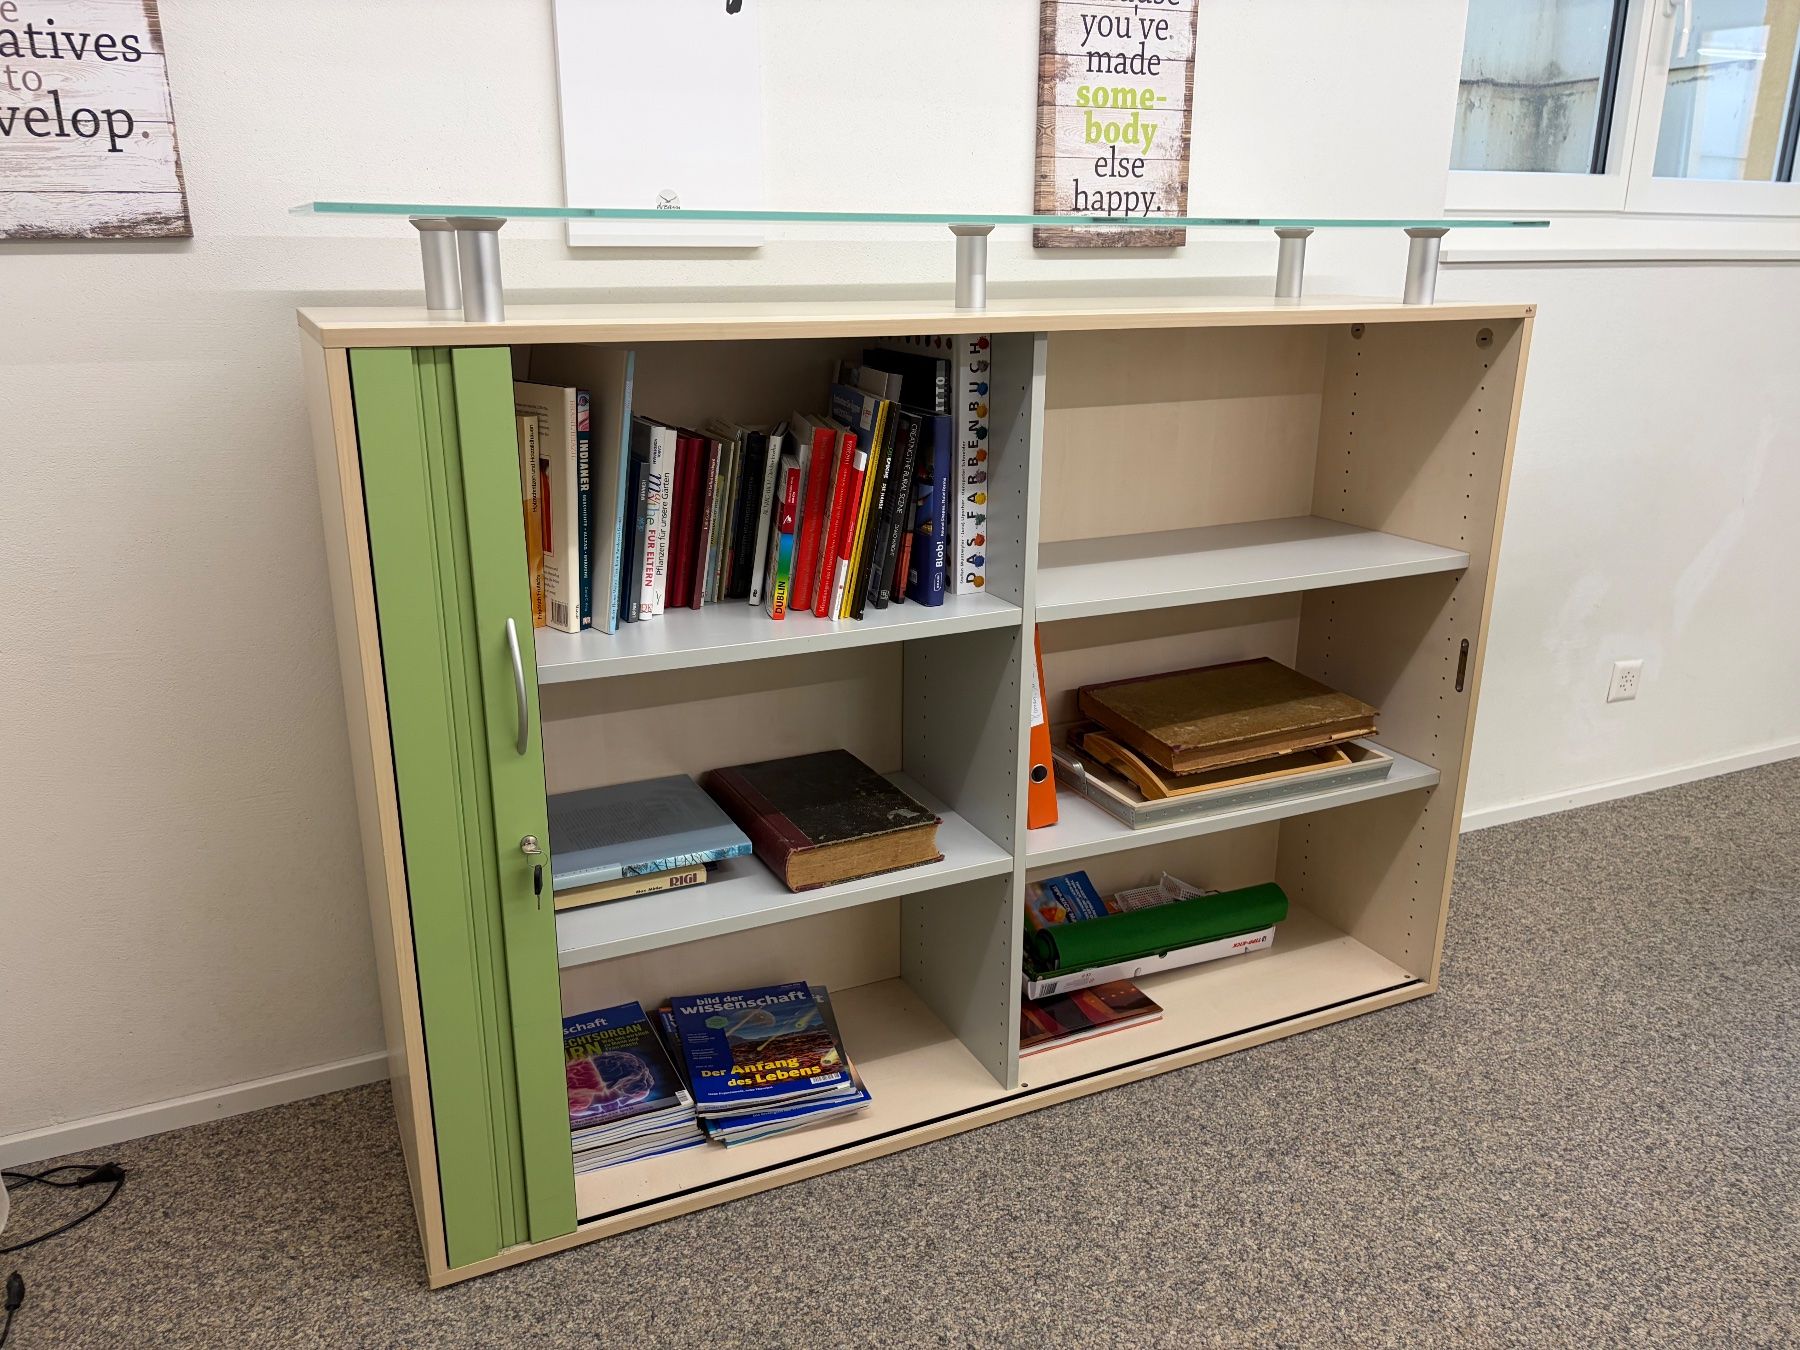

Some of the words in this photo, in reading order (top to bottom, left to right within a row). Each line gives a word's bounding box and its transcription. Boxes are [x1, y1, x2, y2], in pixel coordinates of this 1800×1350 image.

[1086, 42, 1161, 76] made
[3, 64, 43, 92] to
[1076, 85, 1167, 110] some-
[1084, 111, 1157, 156] body
[1094, 146, 1145, 177] else
[1071, 179, 1162, 217] happy.
[579, 439, 590, 492] INDIANER
[661, 472, 670, 499] Gärten
[899, 470, 910, 492] RURAL
[660, 501, 668, 527] unsere
[879, 493, 887, 510] HANSE
[896, 492, 907, 515] SCENE
[658, 528, 667, 540] für
[655, 542, 666, 577] Pflanzen
[934, 540, 943, 568] Blob!
[966, 537, 980, 583] DAS
[645, 551, 656, 587] ELTERN
[775, 581, 785, 614] DUBLIN
[669, 872, 698, 888] RIGI
[680, 990, 807, 1015] wissenschaft
[696, 996, 721, 1007] bild
[723, 995, 744, 1003] der
[701, 1069, 727, 1078] Der
[730, 1057, 800, 1075] Anfang
[727, 1074, 752, 1087] des
[755, 1064, 822, 1083] Lebens
